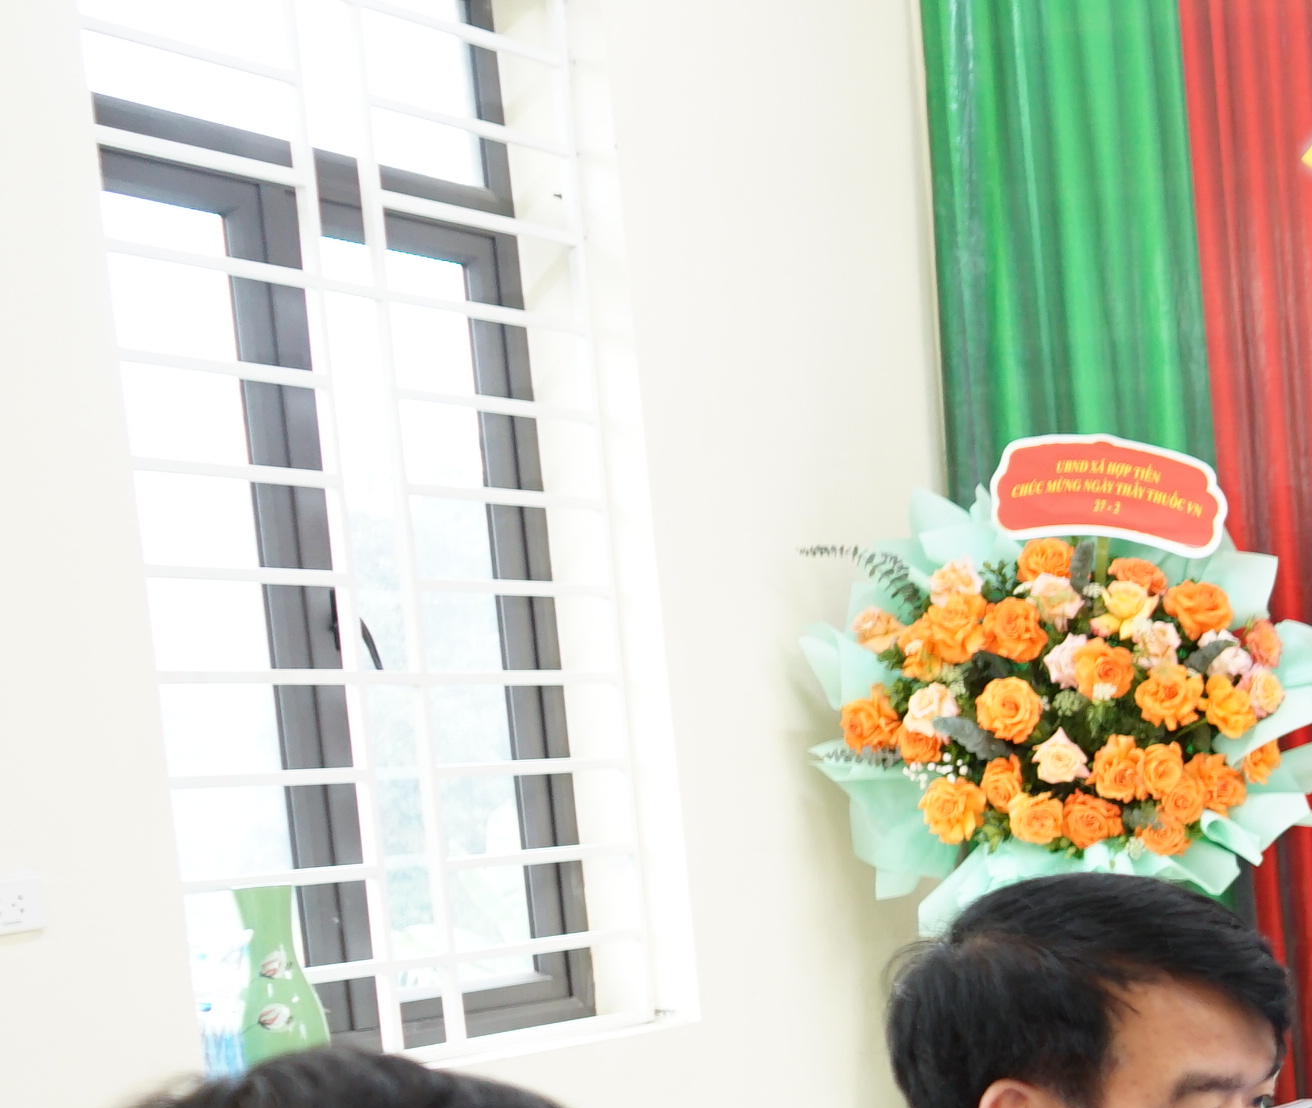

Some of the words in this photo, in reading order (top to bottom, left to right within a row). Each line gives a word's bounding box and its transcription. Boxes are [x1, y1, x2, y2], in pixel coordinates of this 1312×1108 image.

[1056, 459, 1089, 474] UBND
[1106, 461, 1133, 479] HỢP
[1133, 463, 1161, 484] TIẾN
[1011, 478, 1045, 499] CHÚC
[1045, 475, 1082, 494] MỪNG
[1083, 477, 1116, 495] NGÀY
[1146, 489, 1187, 512] THUỐC
[1186, 500, 1203, 518] VN
